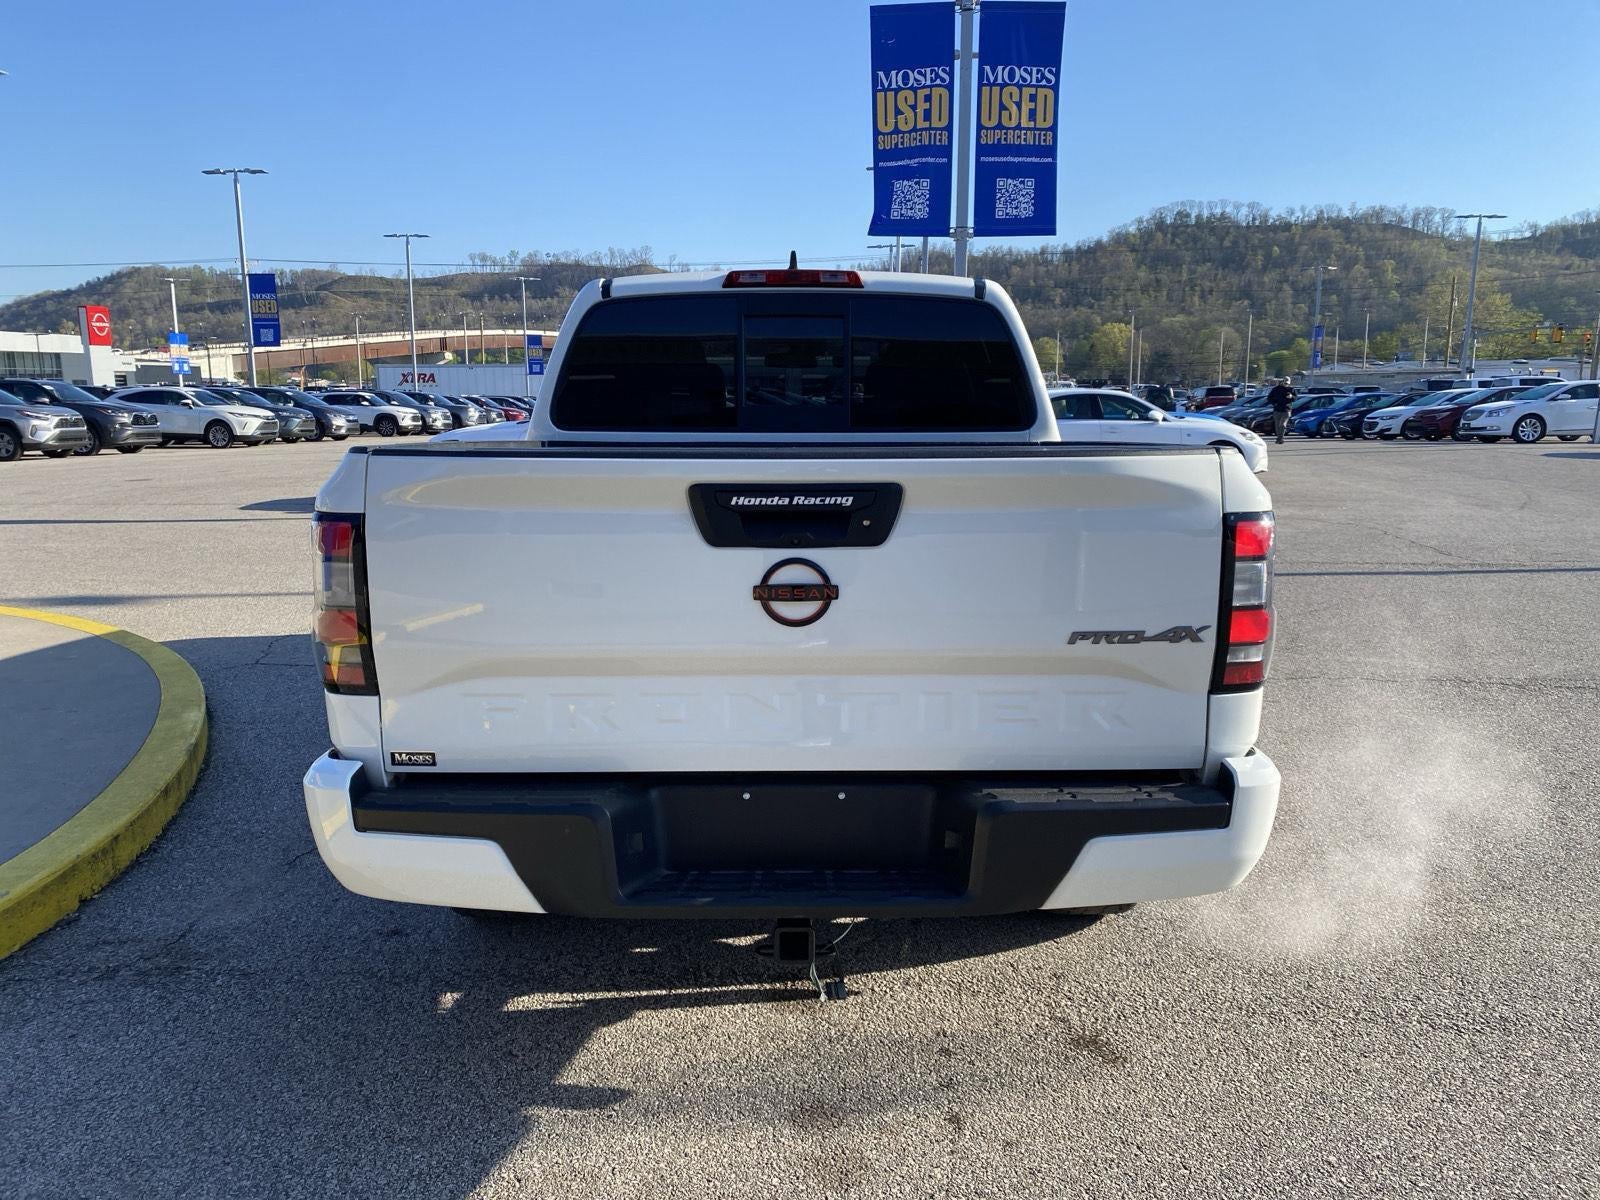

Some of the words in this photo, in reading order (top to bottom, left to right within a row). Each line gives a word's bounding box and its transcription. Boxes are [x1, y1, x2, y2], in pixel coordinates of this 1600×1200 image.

[876, 66, 950, 90] MOSES
[981, 65, 1056, 86] MOSES
[876, 87, 950, 133] USED
[980, 86, 1055, 128] USED
[877, 130, 949, 150] SUPERCENTER
[980, 129, 1053, 146] SUPERCENTER
[252, 300, 278, 314] USED
[730, 496, 789, 506] Honda
[792, 495, 854, 507] Racing
[755, 586, 838, 601] NISSAN
[460, 692, 1133, 734] FRONTIER
[394, 753, 434, 765] MOSES
